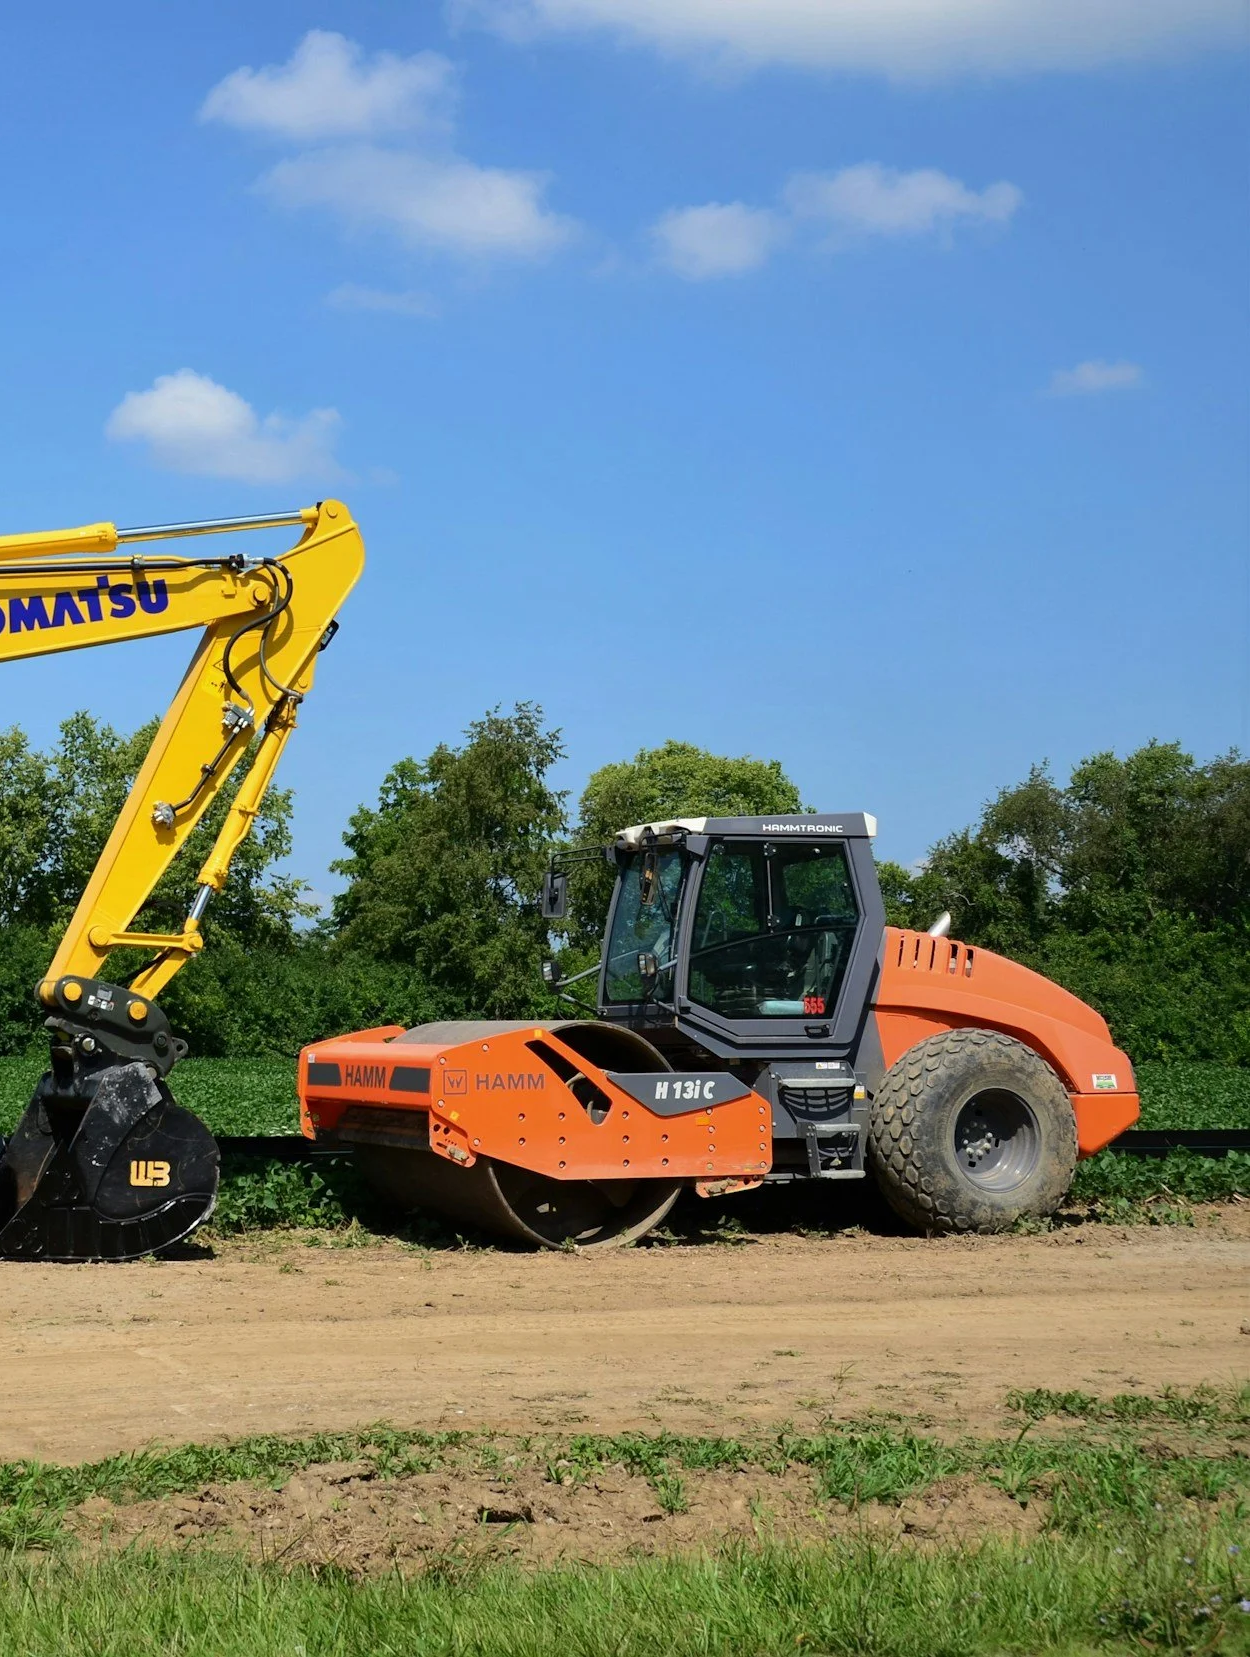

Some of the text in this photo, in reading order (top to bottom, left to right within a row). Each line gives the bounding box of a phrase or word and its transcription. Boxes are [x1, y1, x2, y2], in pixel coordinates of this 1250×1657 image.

[762, 824, 844, 833] HAMMTRONIC
[345, 1064, 387, 1089] HAMM
[476, 1074, 545, 1090] HAMM
[654, 1081, 669, 1100] H
[703, 1080, 716, 1100] C
